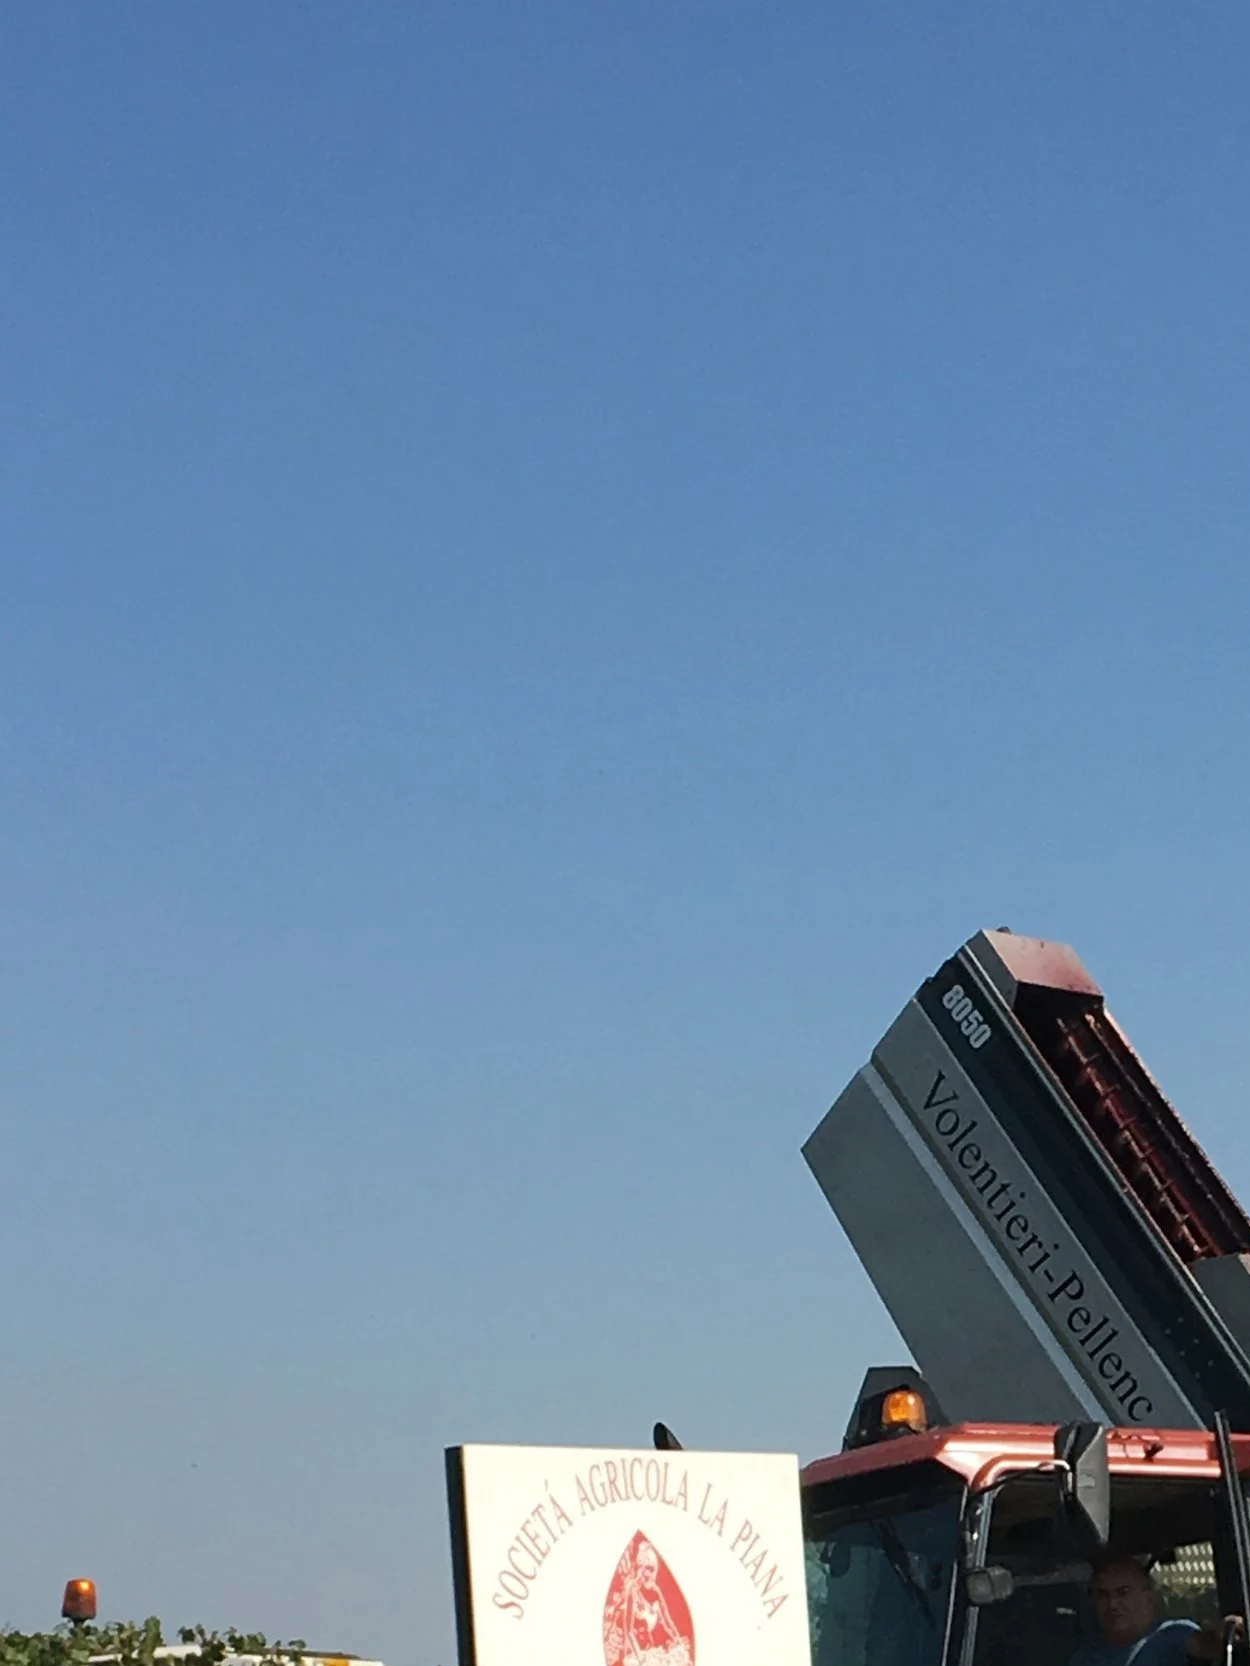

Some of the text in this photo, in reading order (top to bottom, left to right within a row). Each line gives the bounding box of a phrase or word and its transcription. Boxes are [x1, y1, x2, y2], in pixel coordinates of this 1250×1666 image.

[942, 984, 993, 1050] 8050
[922, 1069, 1153, 1422] Volentieri-Pellenc
[574, 1457, 689, 1516] AGRICOLA
[698, 1483, 729, 1537] LA
[729, 1519, 790, 1620] PIANA
